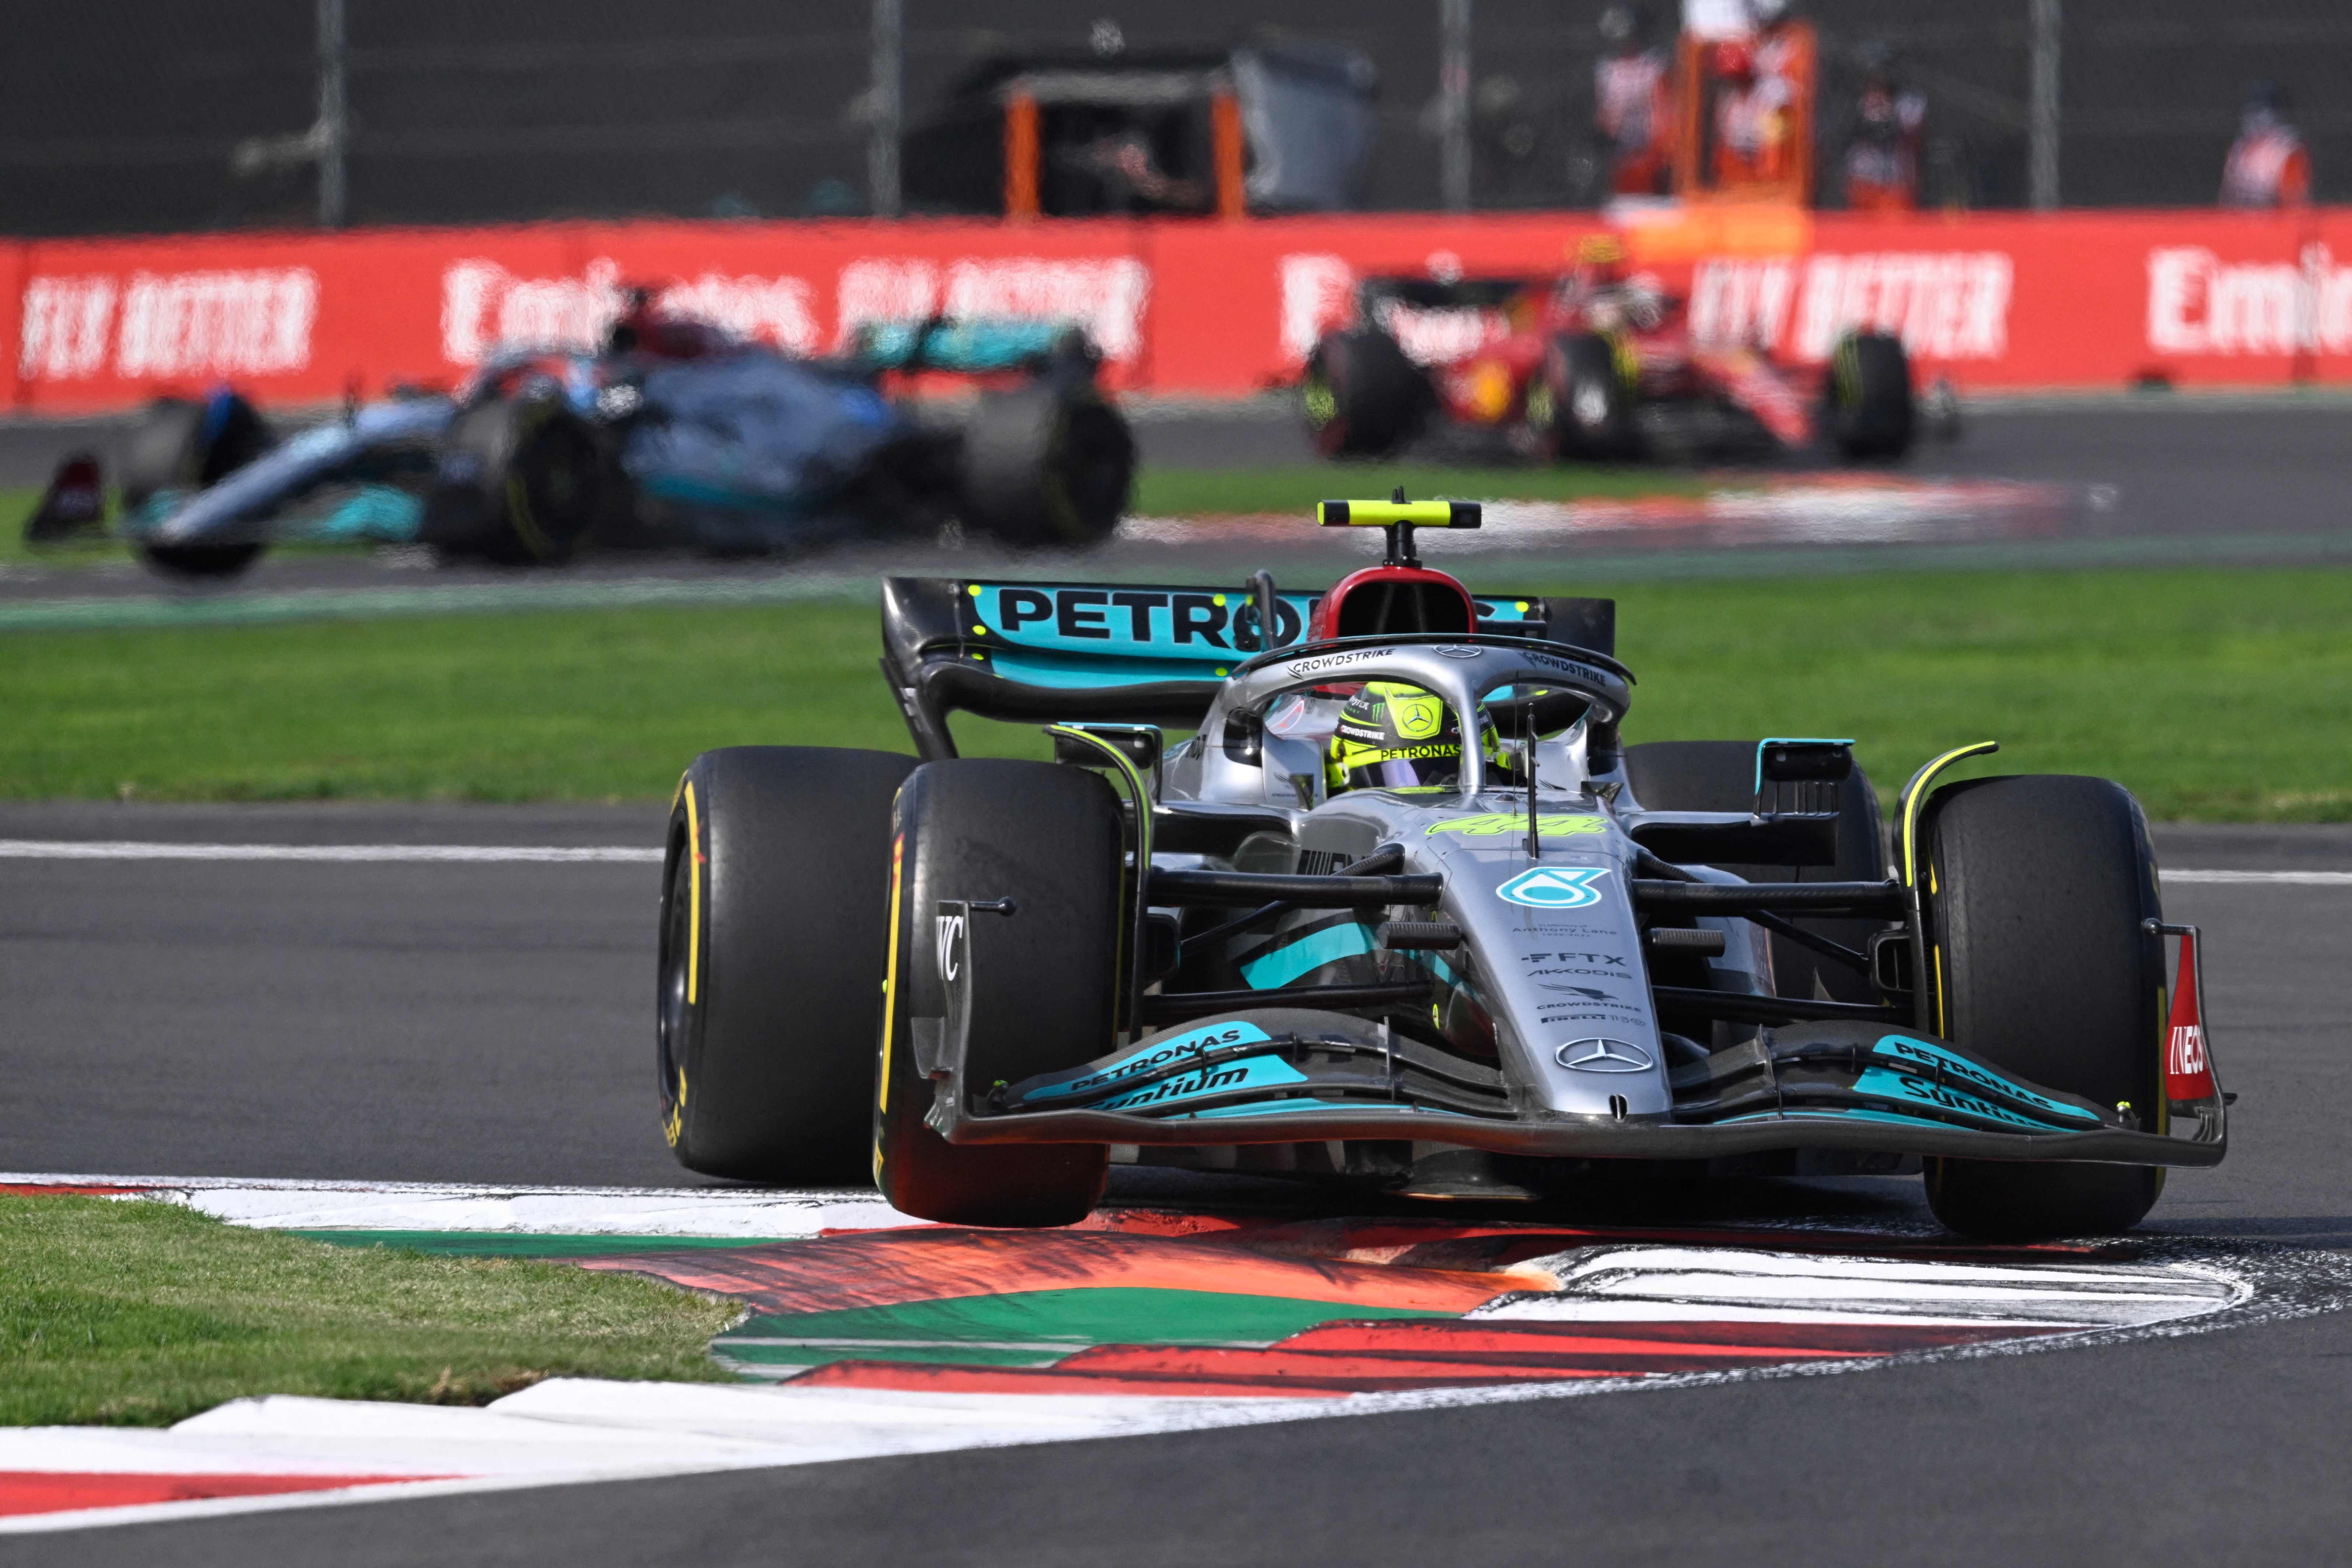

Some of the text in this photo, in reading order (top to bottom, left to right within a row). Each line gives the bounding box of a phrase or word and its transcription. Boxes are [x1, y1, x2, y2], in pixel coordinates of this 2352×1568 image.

[1293, 648, 1395, 672] CROWDSTRIKE
[1523, 651, 1605, 687] CROWDSTRIKE
[1381, 743, 1461, 760] PETRONAS
[1425, 813, 1608, 836] 44
[1558, 953, 1627, 967] FTX
[1537, 1002, 1642, 1012] CROWDSTRIKE
[1071, 1030, 1241, 1091] PETRONAS
[1894, 1042, 2054, 1109] PETRONAS
